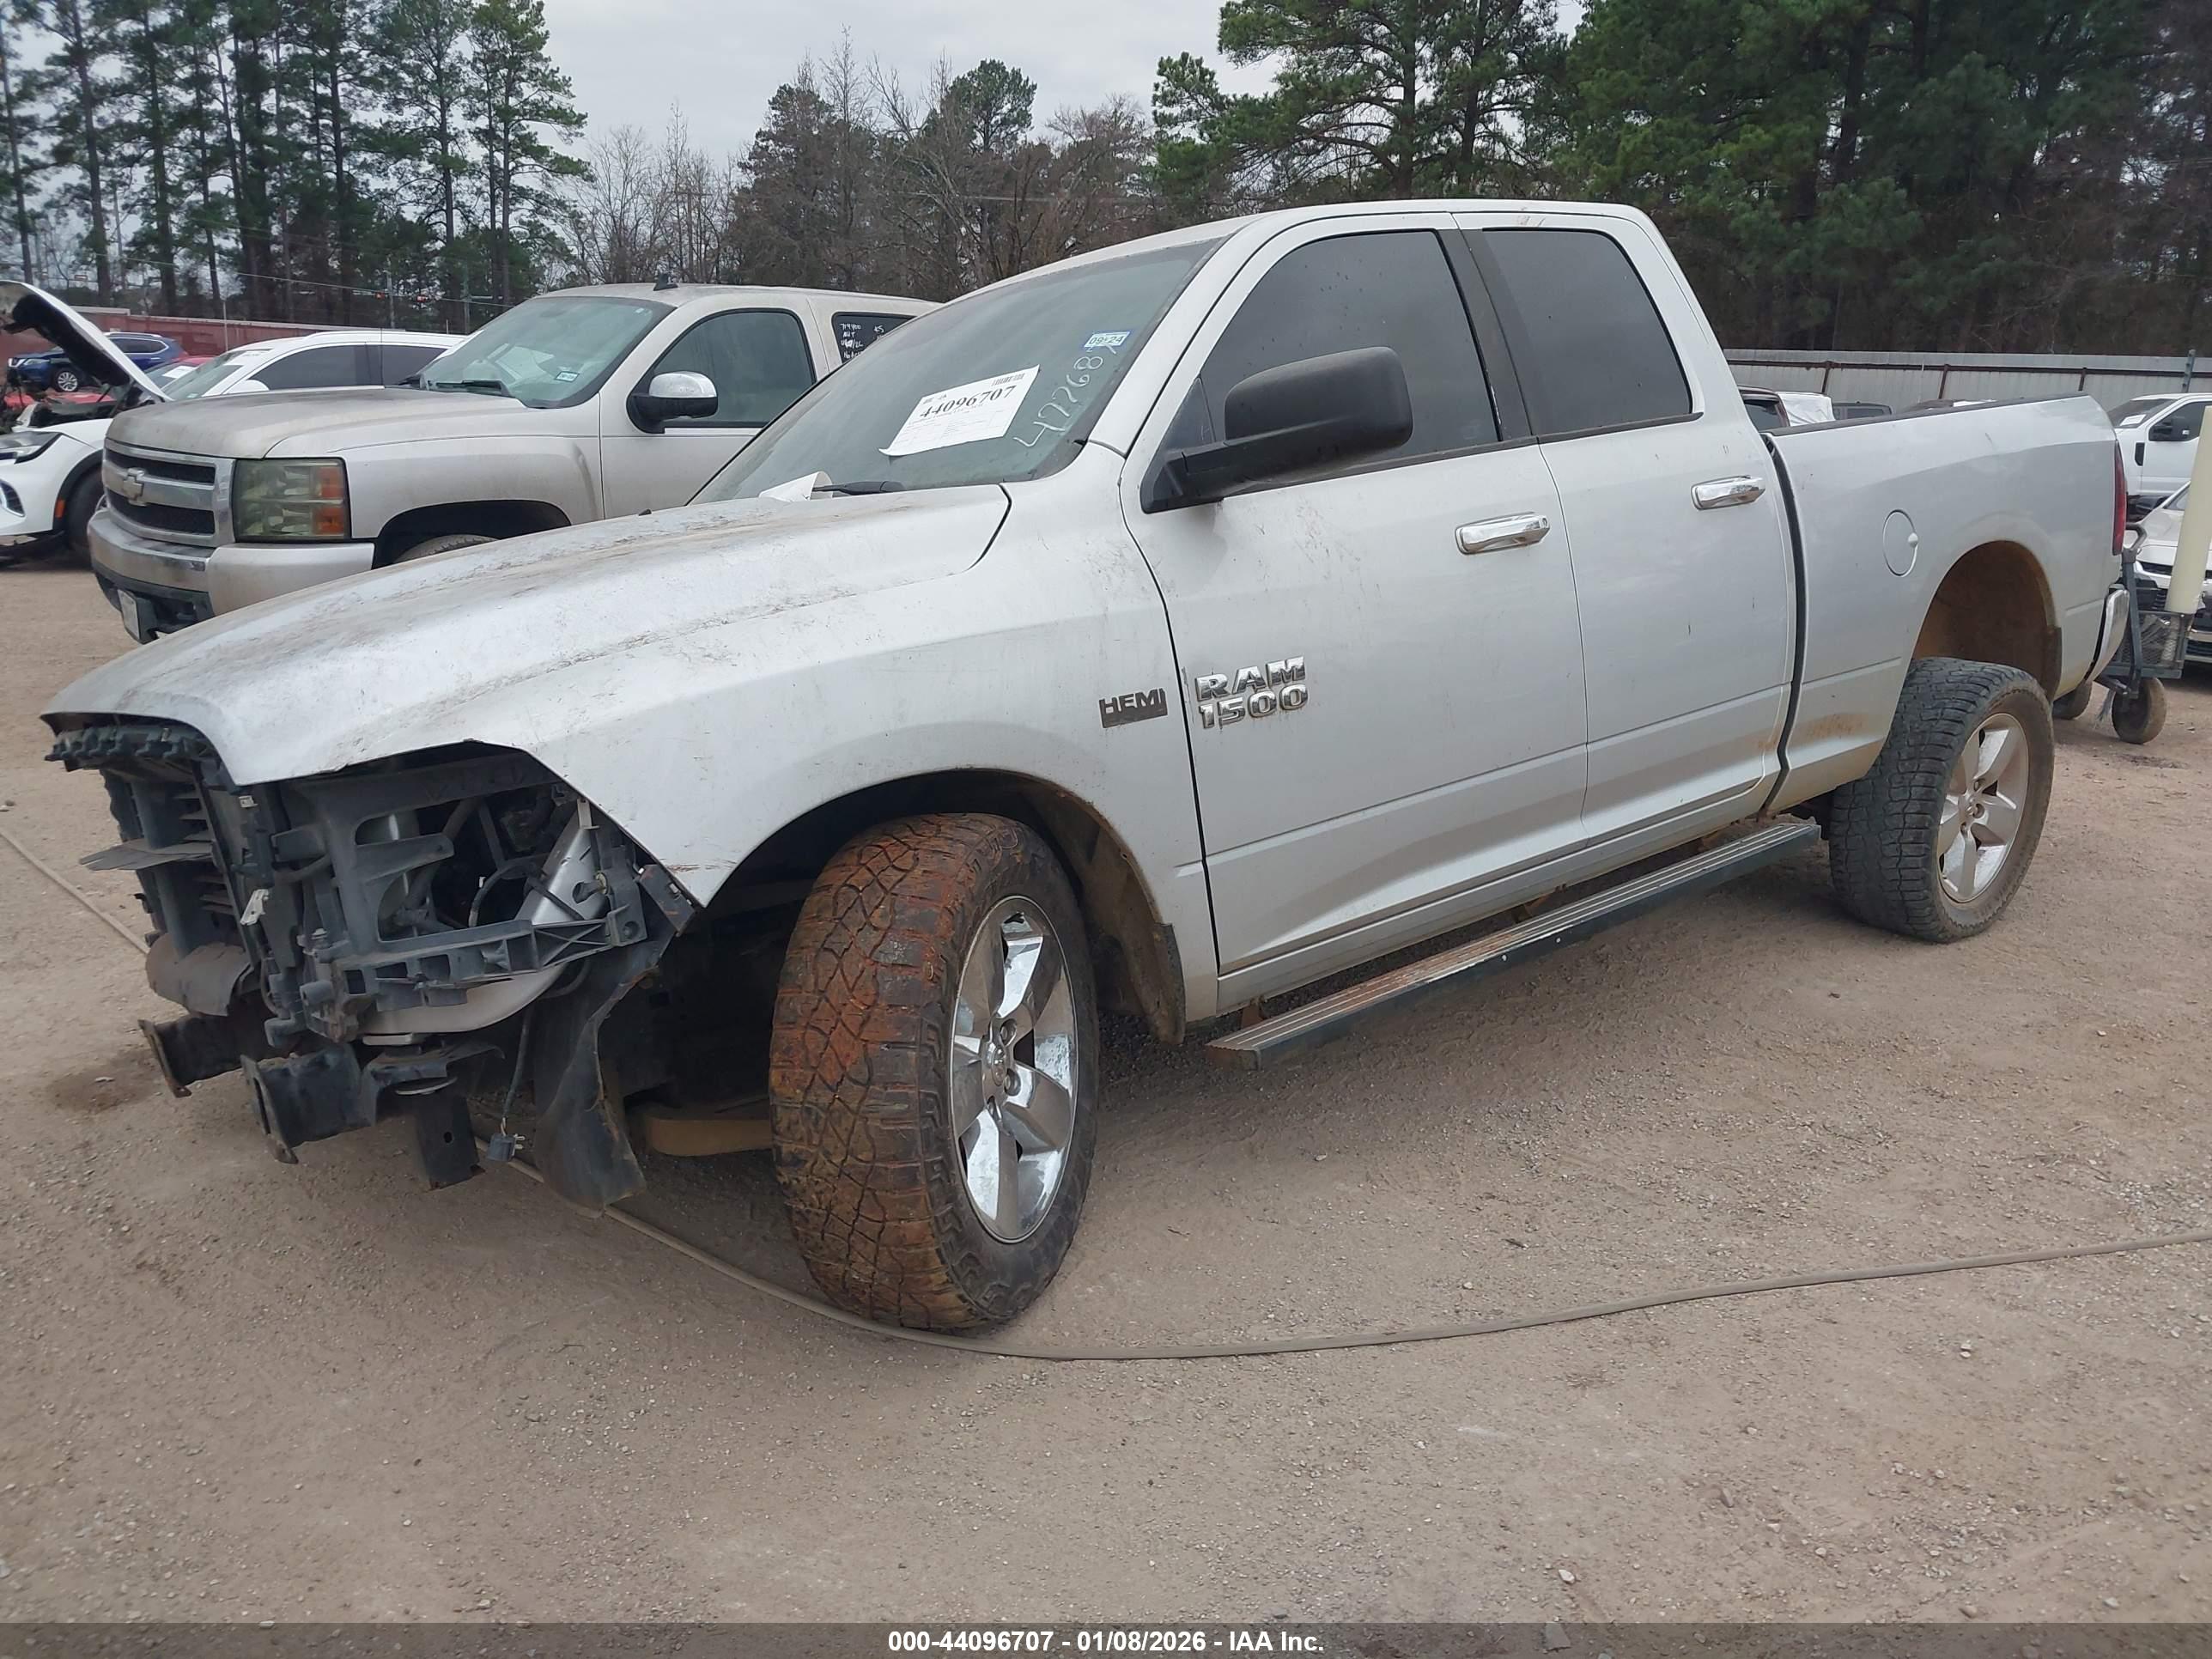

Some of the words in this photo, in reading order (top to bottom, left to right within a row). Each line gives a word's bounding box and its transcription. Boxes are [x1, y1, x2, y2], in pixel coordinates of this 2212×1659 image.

[920, 384, 1017, 418] 44096707
[1194, 656, 1306, 702] RAM
[1099, 688, 1168, 728] HEMI
[1198, 684, 1309, 730] 1500
